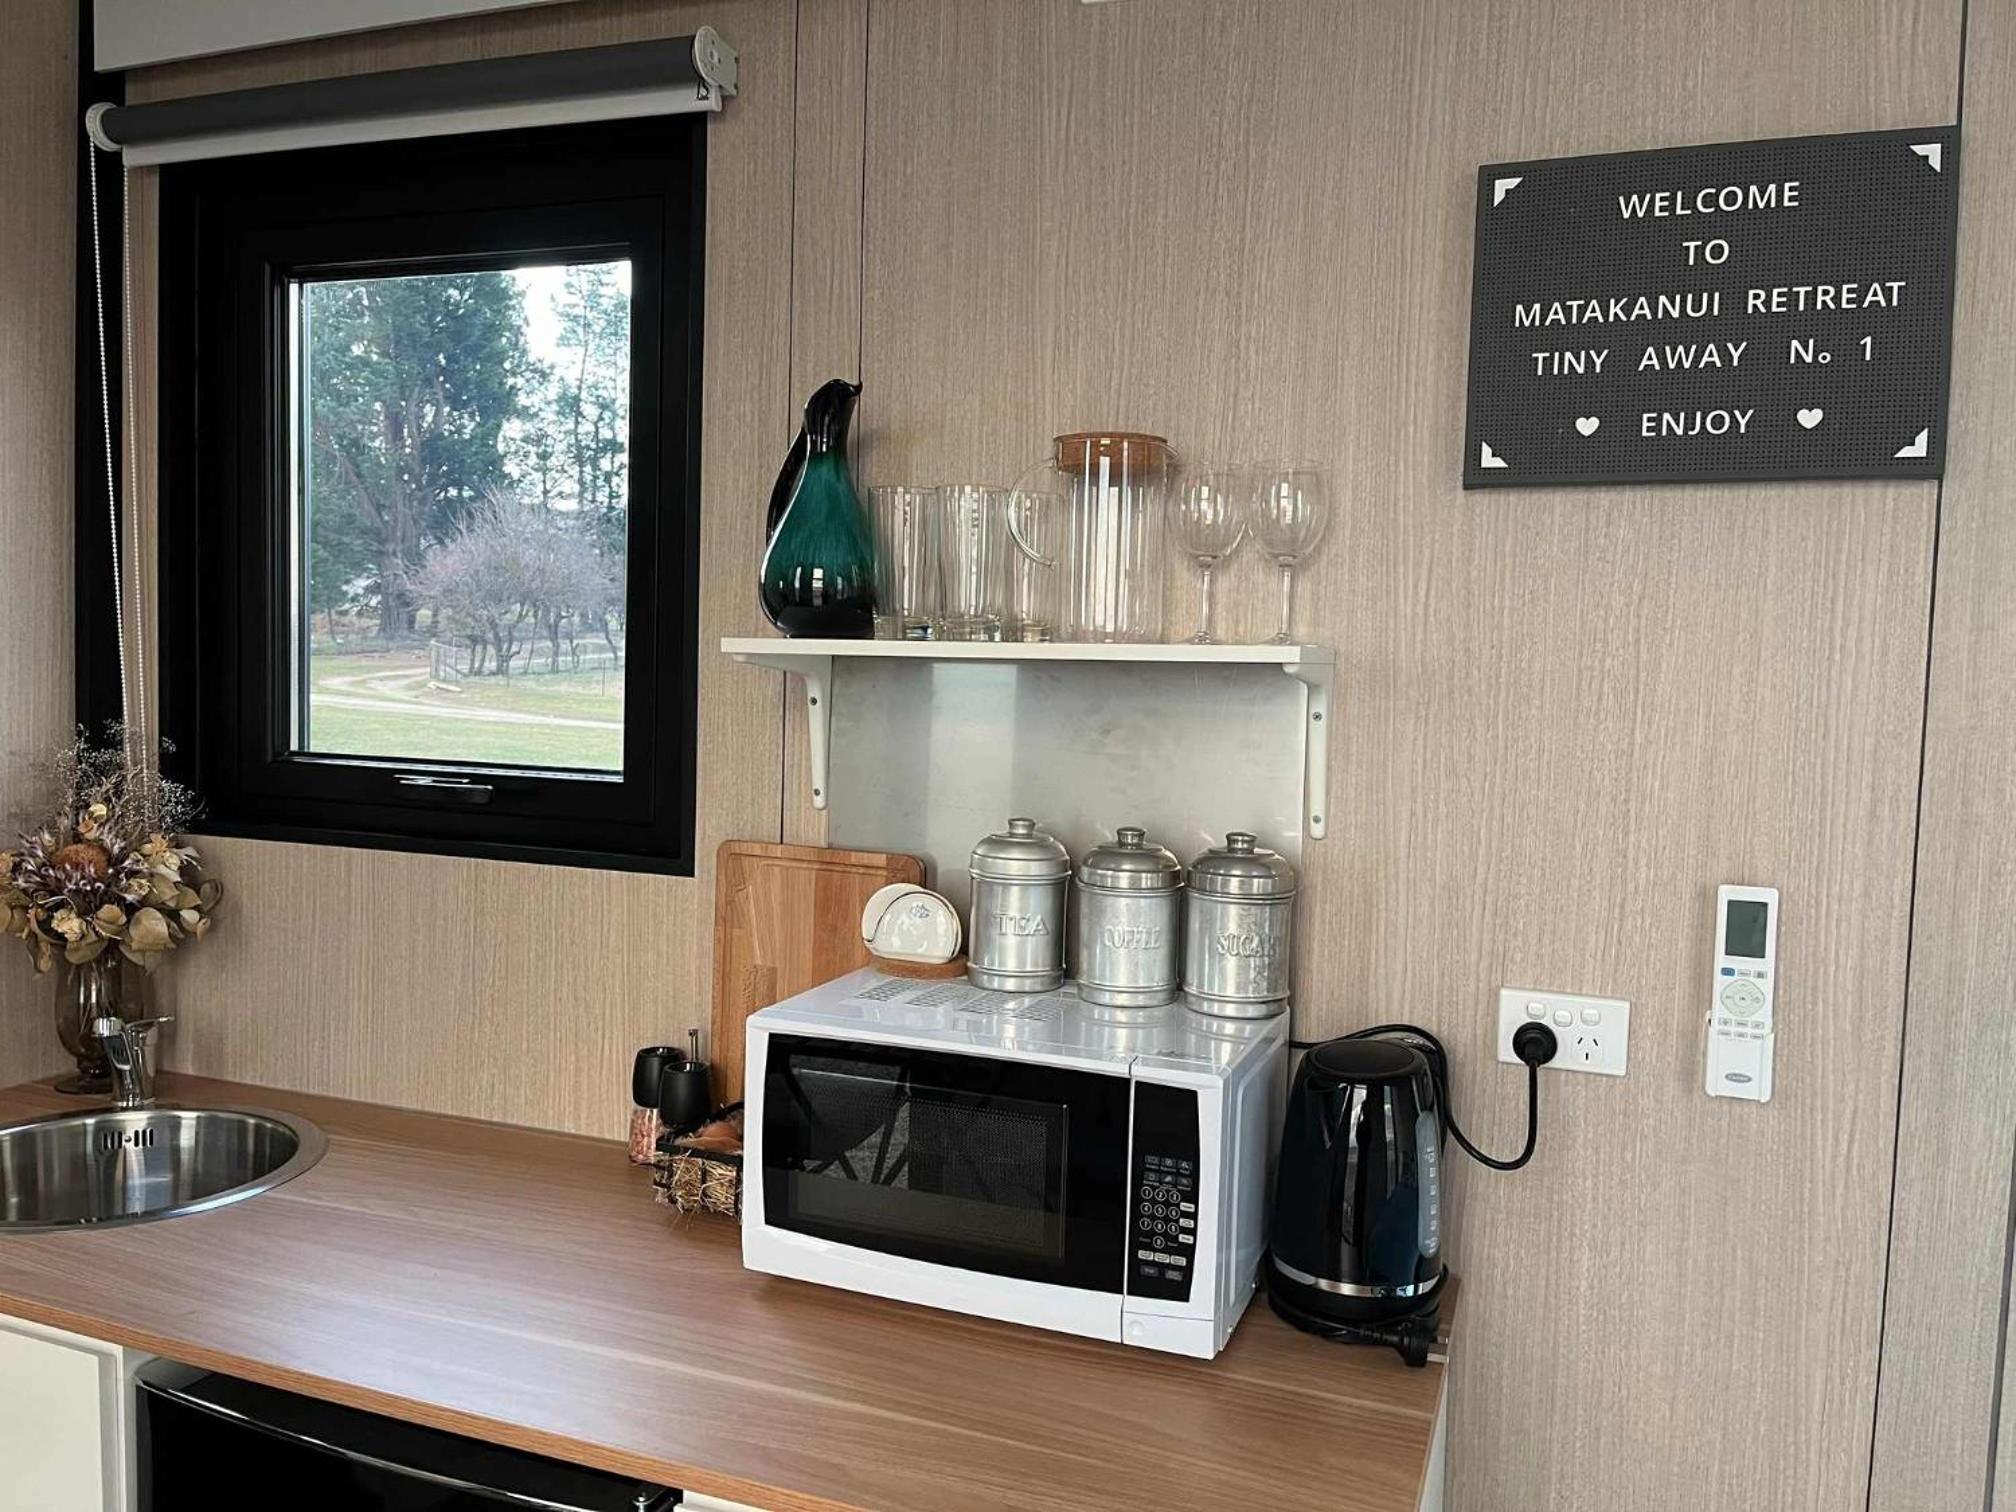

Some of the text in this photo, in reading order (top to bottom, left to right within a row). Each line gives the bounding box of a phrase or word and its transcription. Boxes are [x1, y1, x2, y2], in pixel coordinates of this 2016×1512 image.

[1618, 181, 1800, 219] WELCOME
[1682, 239, 1730, 266] TO
[1514, 281, 1906, 328] MATAKANUI RETREAT
[1531, 349, 1609, 376] TINY
[1637, 341, 1748, 371] AWAY
[1859, 335, 1872, 361] 1
[1641, 409, 1754, 437] ENJOY
[994, 911, 1049, 937] TEA
[1216, 931, 1280, 959] SUGAR
